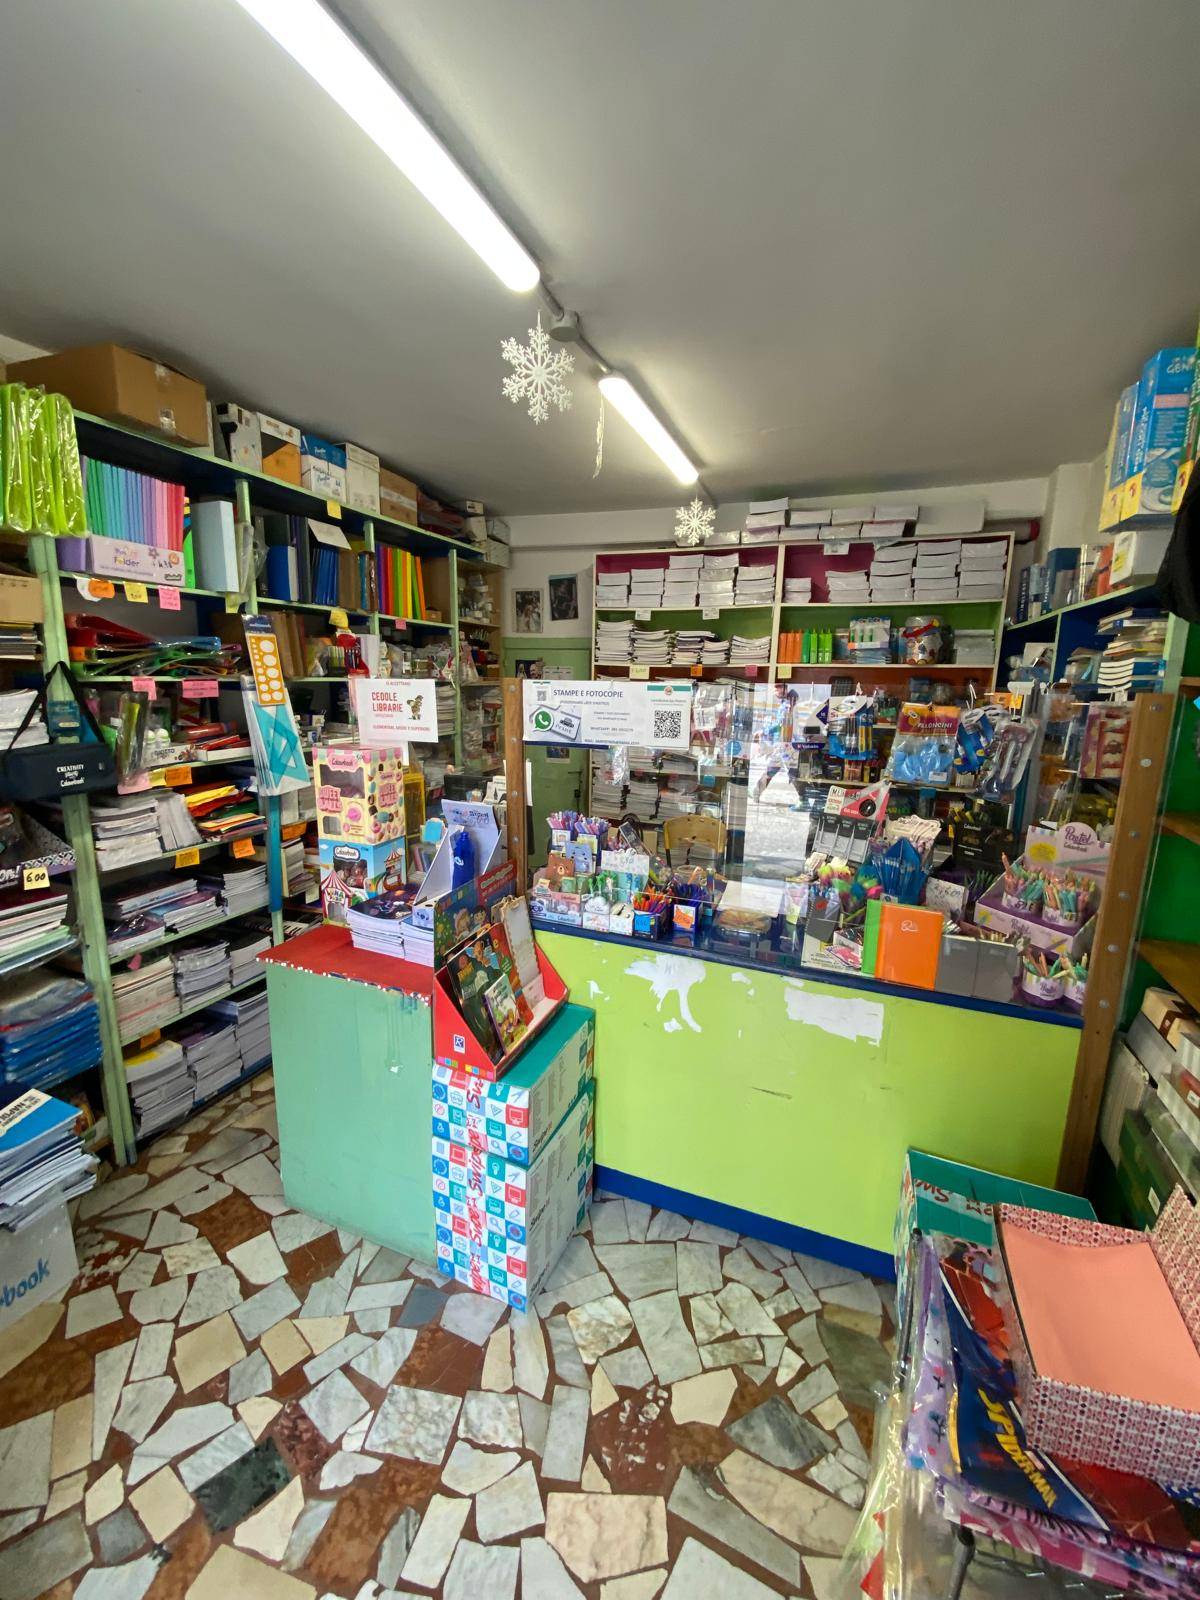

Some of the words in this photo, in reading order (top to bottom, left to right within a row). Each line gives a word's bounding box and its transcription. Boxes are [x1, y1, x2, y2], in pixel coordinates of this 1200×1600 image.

[553, 689, 579, 697] STAMPE
[585, 690, 623, 698] FOTOCOPIE
[372, 702, 404, 712] LIBRARIE
[57, 763, 84, 773] CREATIVITY
[1064, 826, 1095, 846] Pastel
